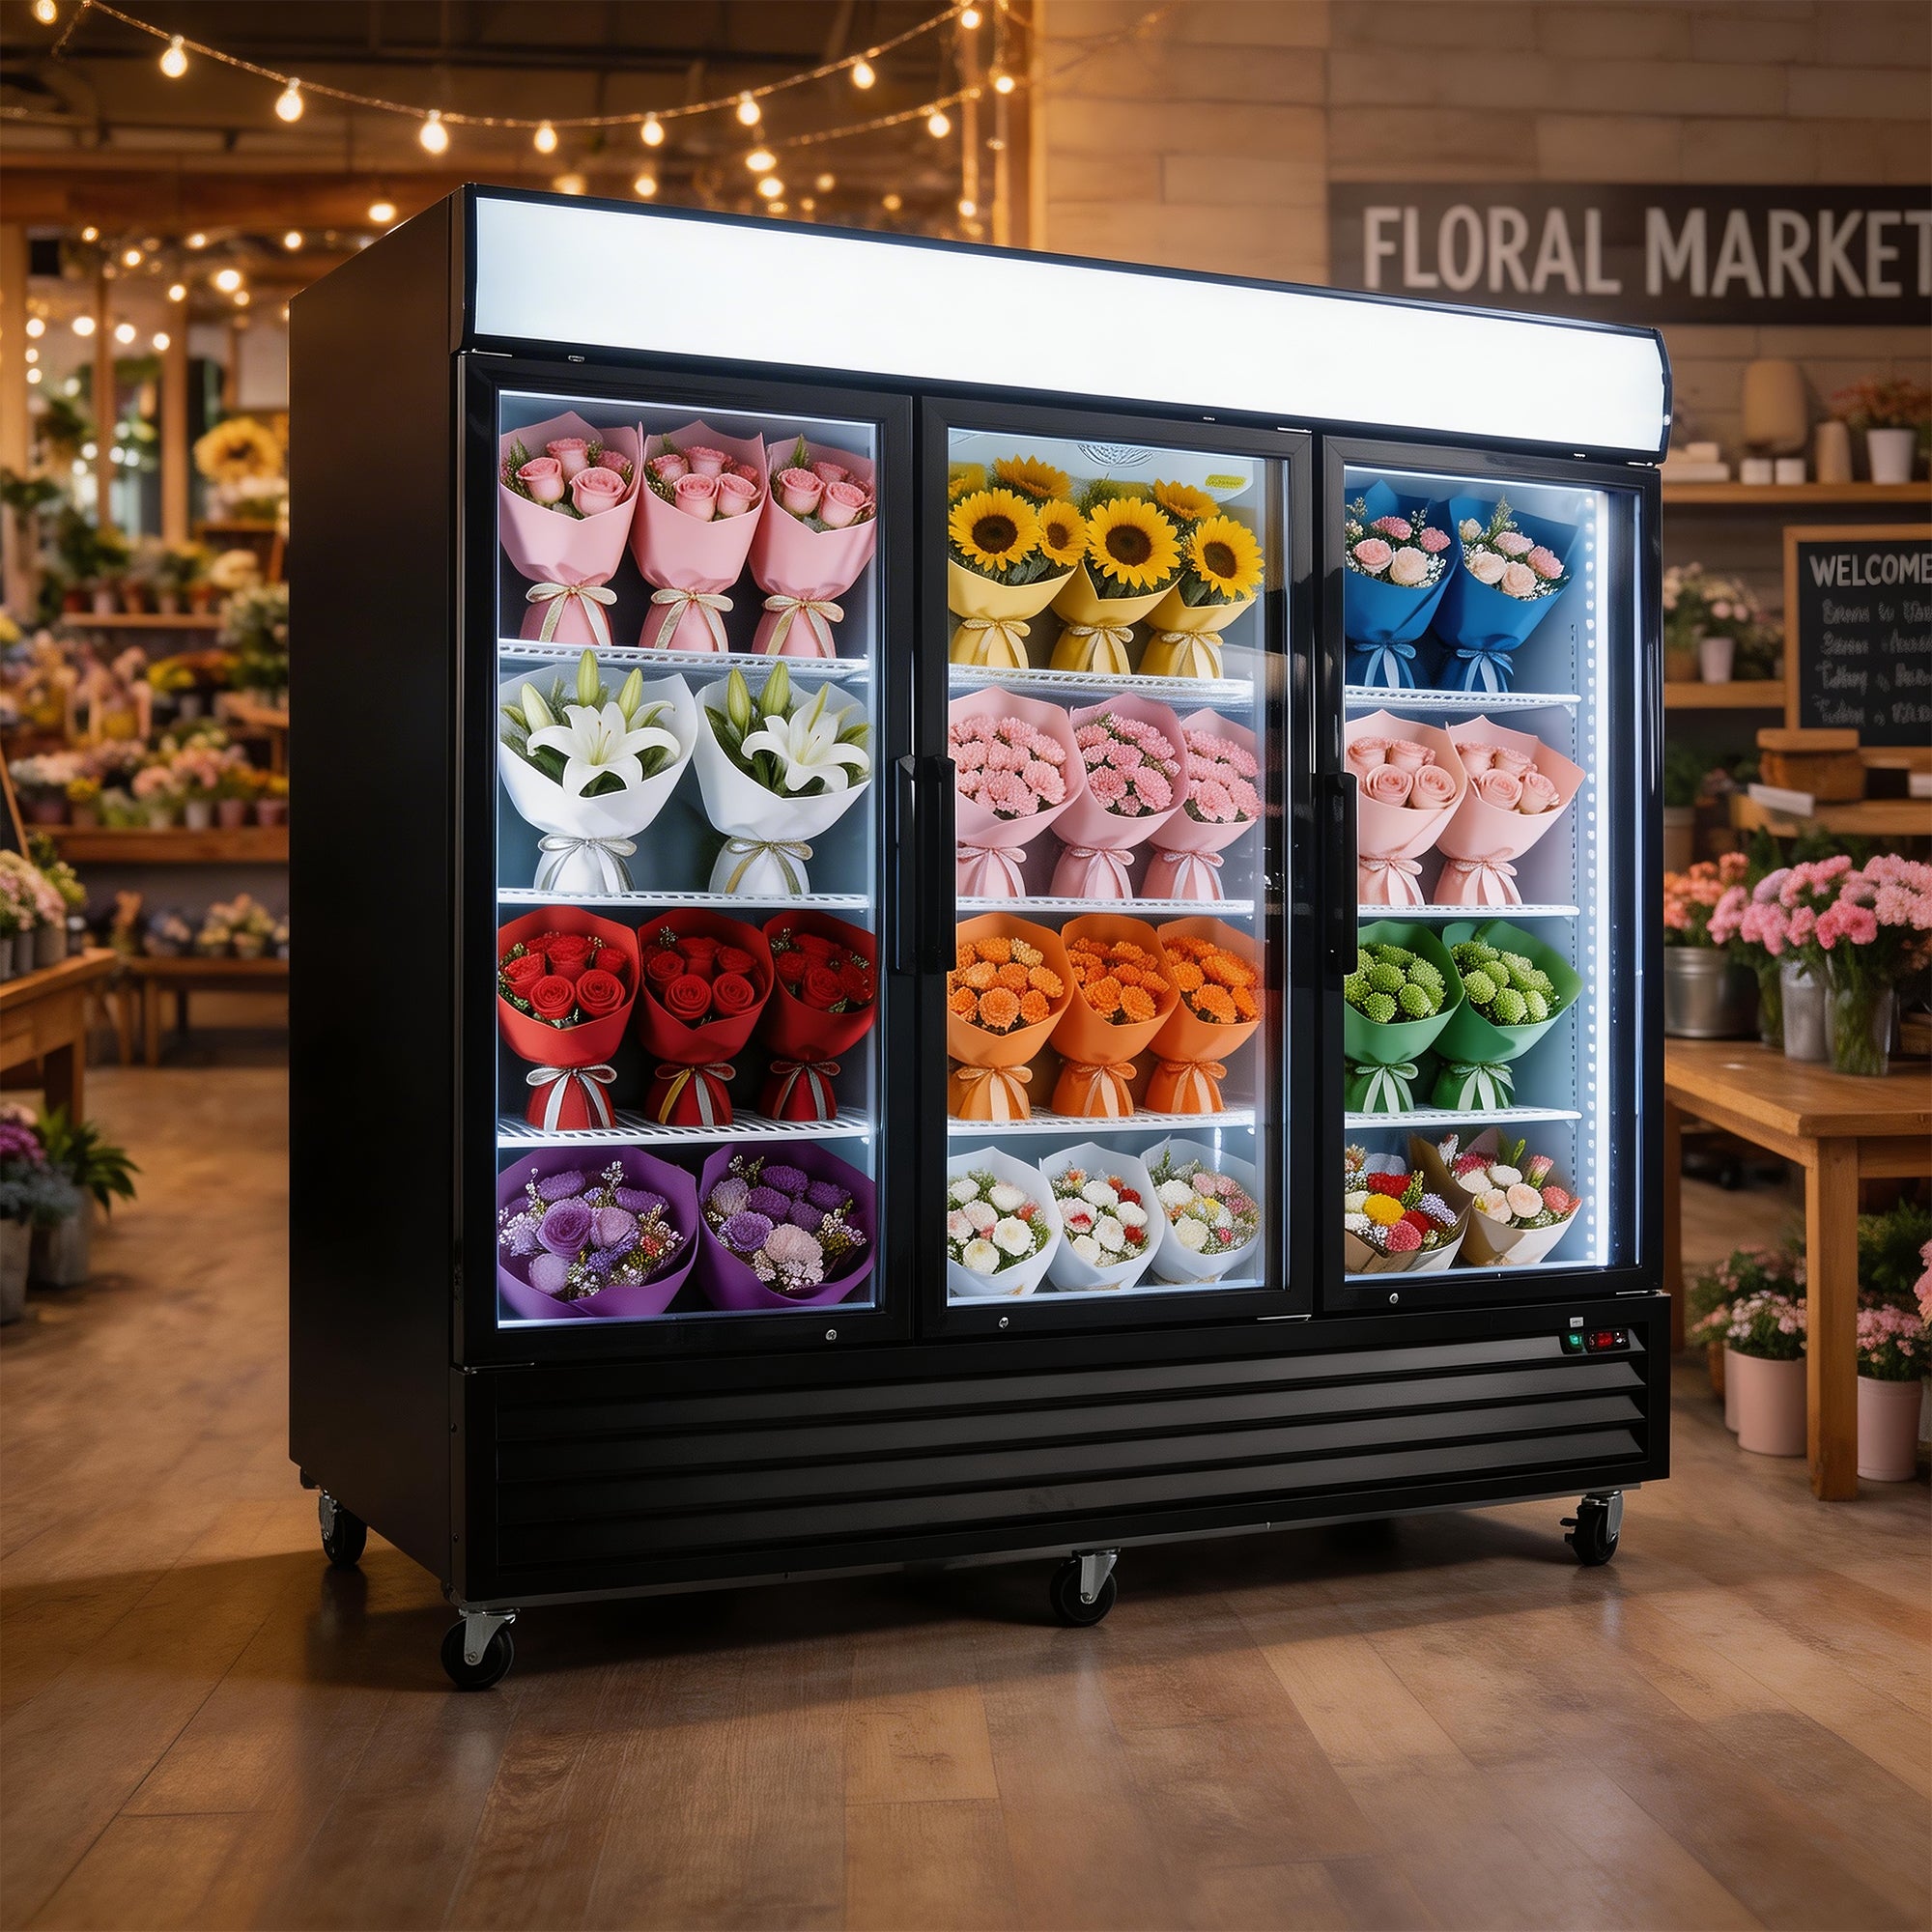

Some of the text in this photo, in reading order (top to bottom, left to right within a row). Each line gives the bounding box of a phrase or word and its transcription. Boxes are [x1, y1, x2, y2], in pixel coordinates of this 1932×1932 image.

[1363, 205, 1932, 298] FLORAL MARKET
[1808, 554, 1932, 587] WELCOME
